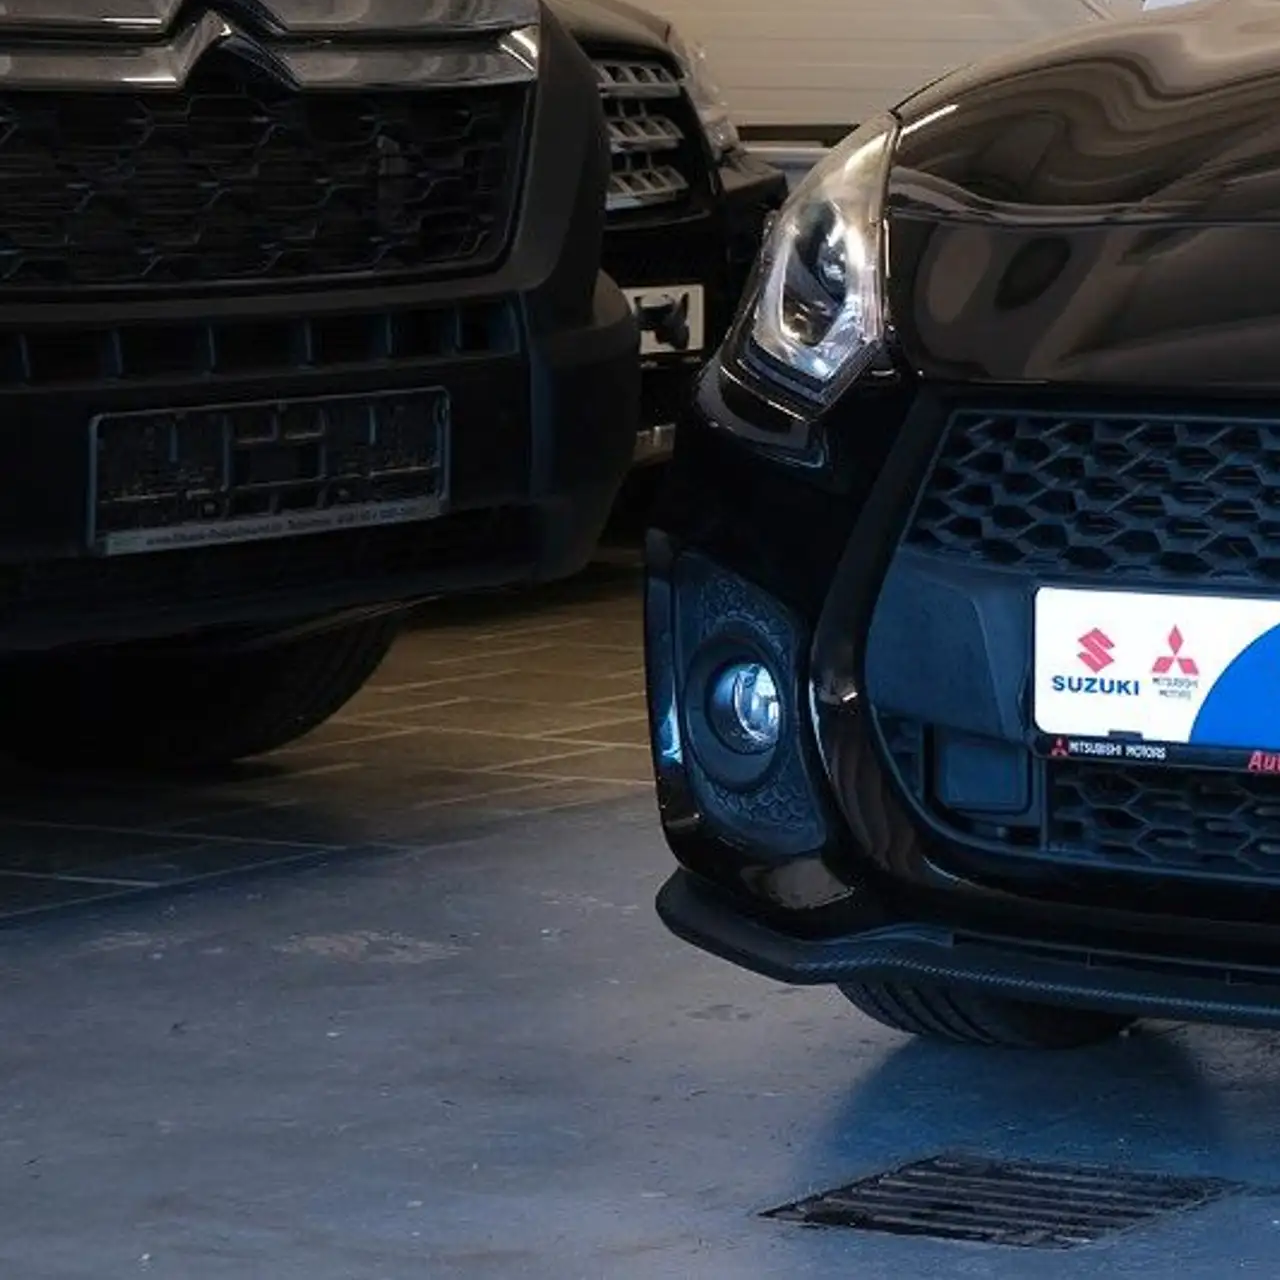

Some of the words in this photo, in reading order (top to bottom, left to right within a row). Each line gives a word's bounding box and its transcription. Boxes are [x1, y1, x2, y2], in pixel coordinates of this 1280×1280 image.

[1051, 675, 1140, 696] SUZUKI
[1068, 740, 1123, 757] MITSUBISHI
[1125, 744, 1167, 760] MOTORS
